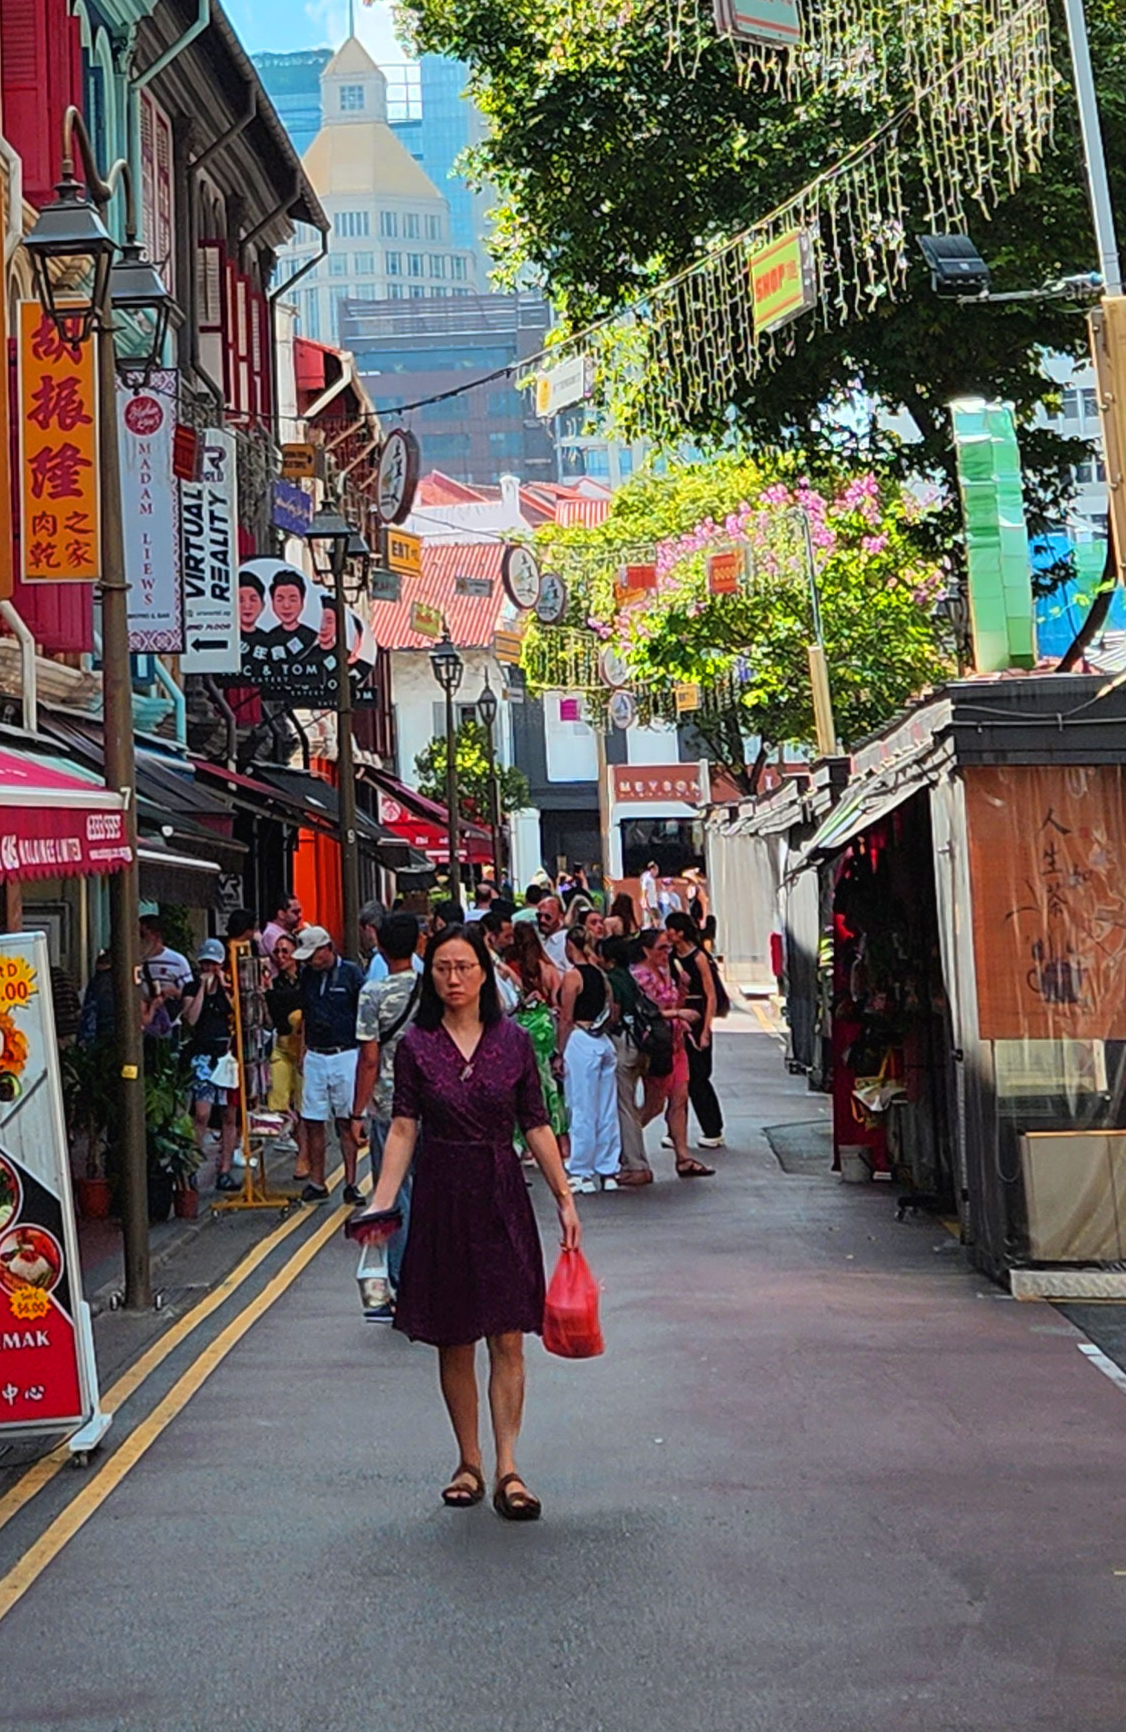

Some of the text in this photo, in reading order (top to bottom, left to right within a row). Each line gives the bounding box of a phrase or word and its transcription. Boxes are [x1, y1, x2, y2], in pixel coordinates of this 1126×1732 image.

[139, 443, 153, 515] MADAM
[184, 489, 205, 598] VIRTUAL
[209, 490, 230, 602] REALITY
[141, 532, 155, 606] LIEWS
[282, 664, 317, 675] TOM
[121, 787, 131, 810] 7
[347, 829, 355, 844] 9
[7, 963, 18, 977] D
